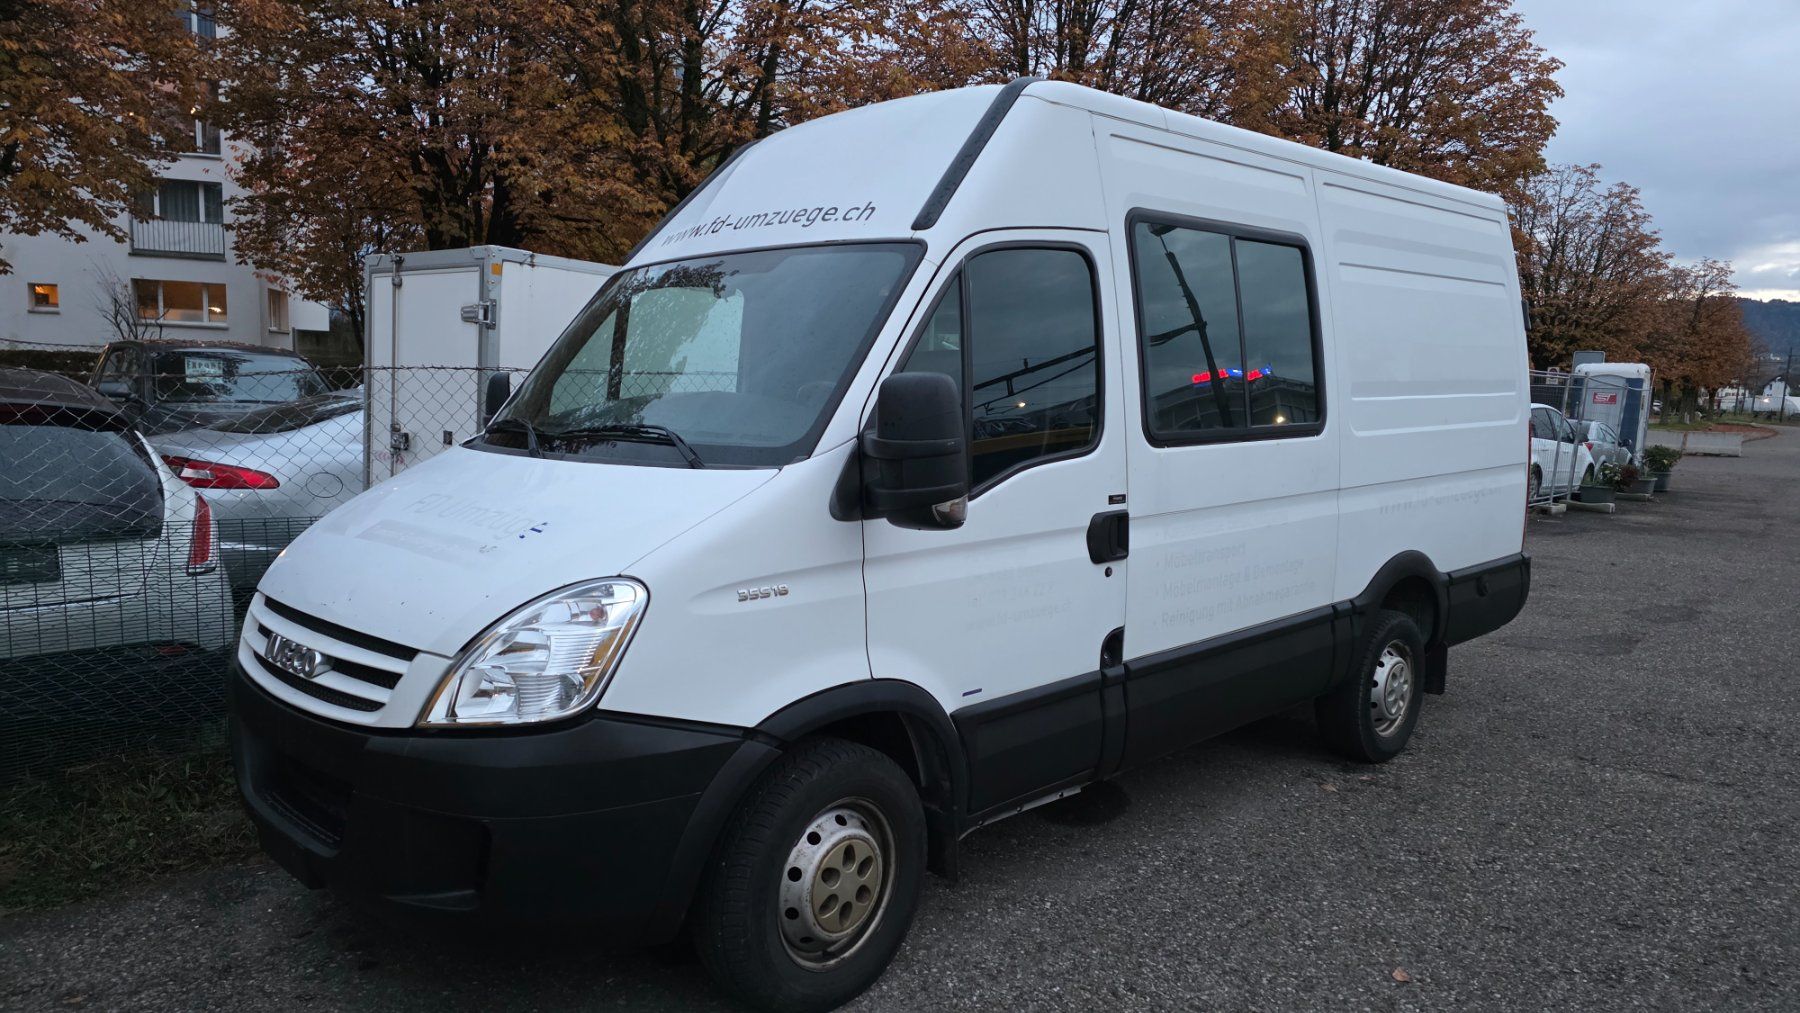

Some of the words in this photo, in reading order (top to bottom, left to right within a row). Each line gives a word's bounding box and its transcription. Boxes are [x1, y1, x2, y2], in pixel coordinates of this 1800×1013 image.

[660, 201, 877, 246] www.fd-umzuege.ch
[737, 583, 790, 603] 35S18
[1160, 604, 1215, 628] Reinigung
[264, 633, 322, 679] IVECO
